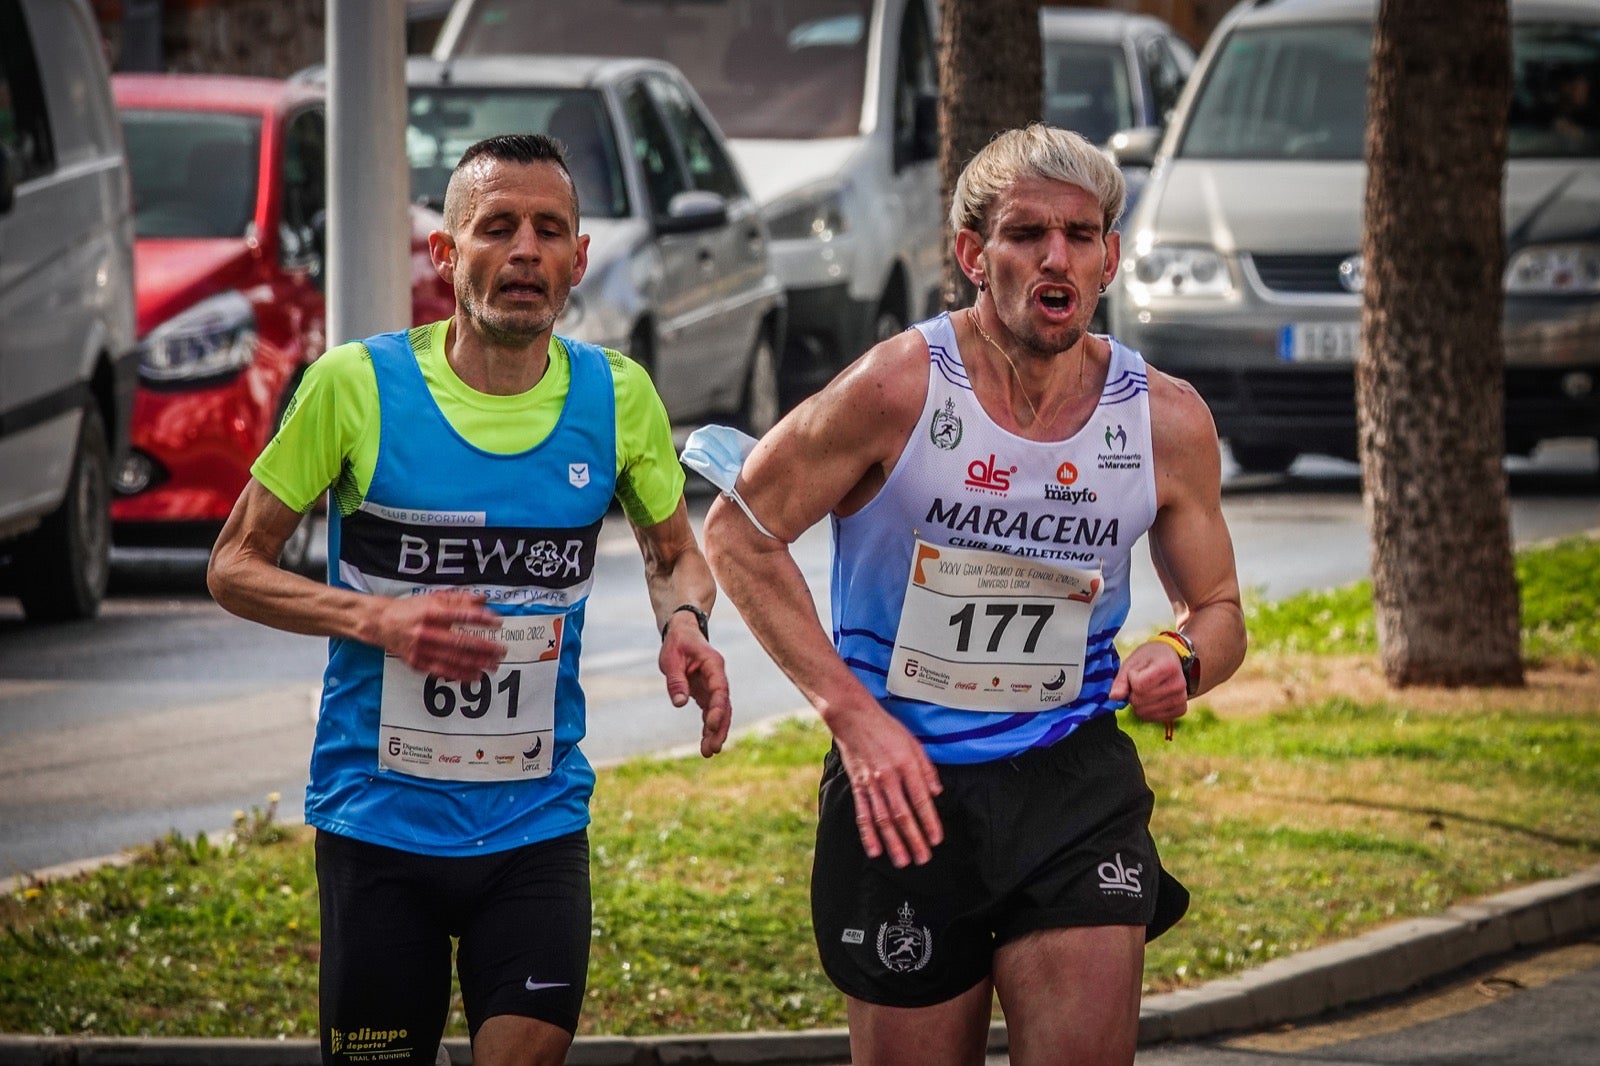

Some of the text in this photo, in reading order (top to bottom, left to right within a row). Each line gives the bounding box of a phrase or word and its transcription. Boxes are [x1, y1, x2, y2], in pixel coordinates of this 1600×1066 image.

[964, 454, 1011, 491] als
[1105, 461, 1141, 469] Maracena
[1044, 488, 1097, 505] mayfo
[380, 508, 476, 524] CLUB DEPORTIVO
[925, 498, 1119, 547] MARACENA
[948, 537, 1095, 563] CLUB DE ATLETISMO
[939, 561, 961, 575] XXXV
[527, 626, 546, 640] 2022
[949, 604, 1055, 653] 177
[423, 669, 521, 719] 691
[1098, 853, 1141, 893] als
[348, 1027, 408, 1043] olimpo
[347, 1042, 387, 1050] deportes
[378, 1052, 411, 1061] RUNNING
